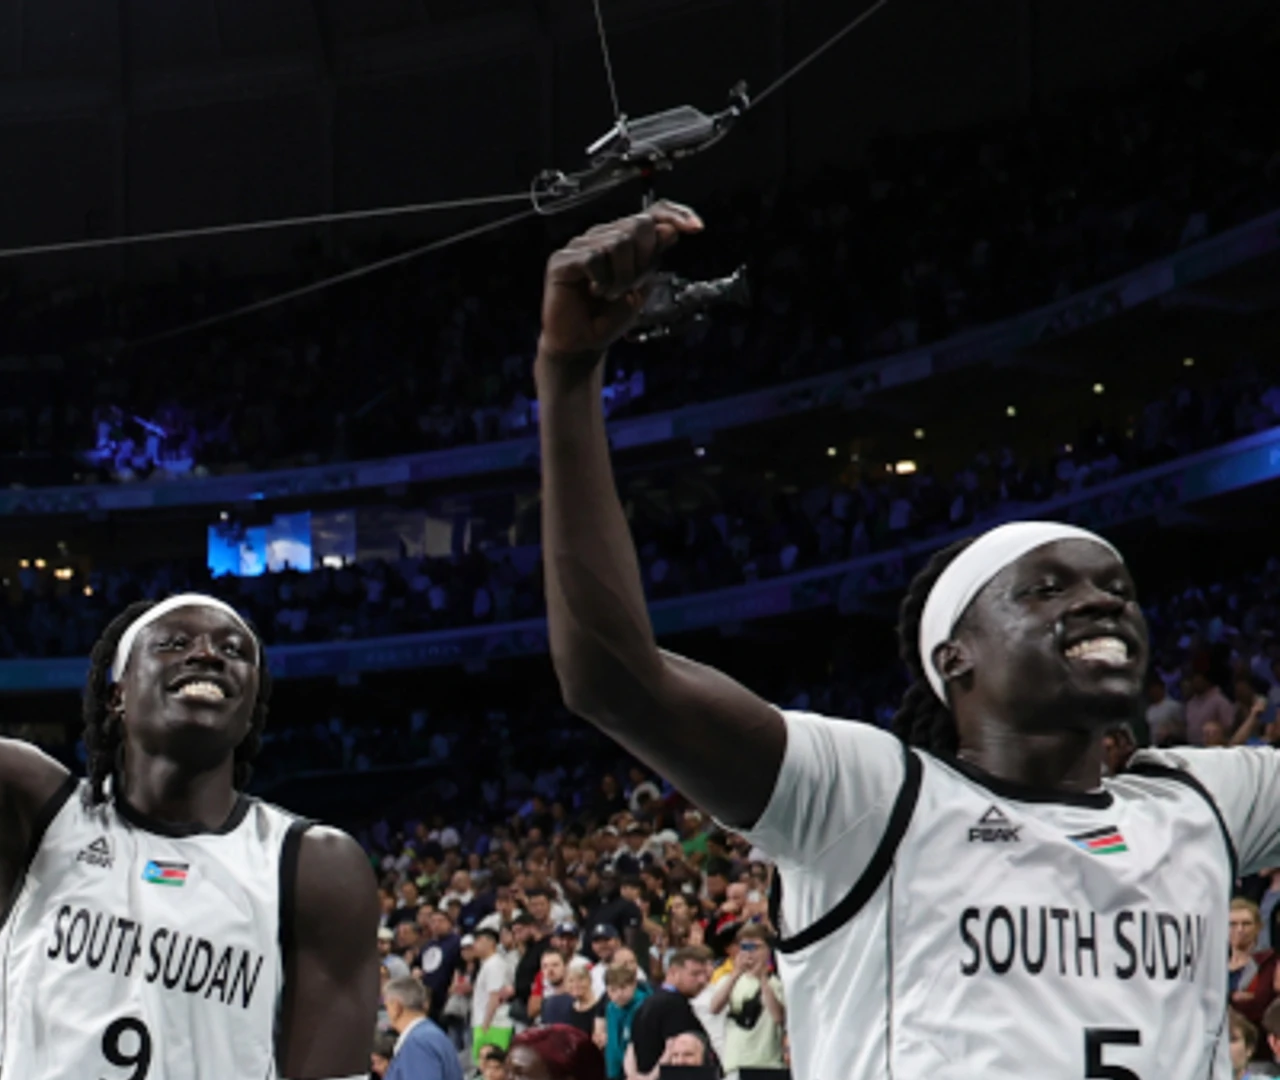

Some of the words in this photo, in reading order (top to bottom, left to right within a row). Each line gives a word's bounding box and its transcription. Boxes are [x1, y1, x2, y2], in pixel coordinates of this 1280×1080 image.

[967, 825, 1025, 843] PEAK
[145, 927, 264, 1009] SUDAN
[959, 905, 1099, 979] SOUTH
